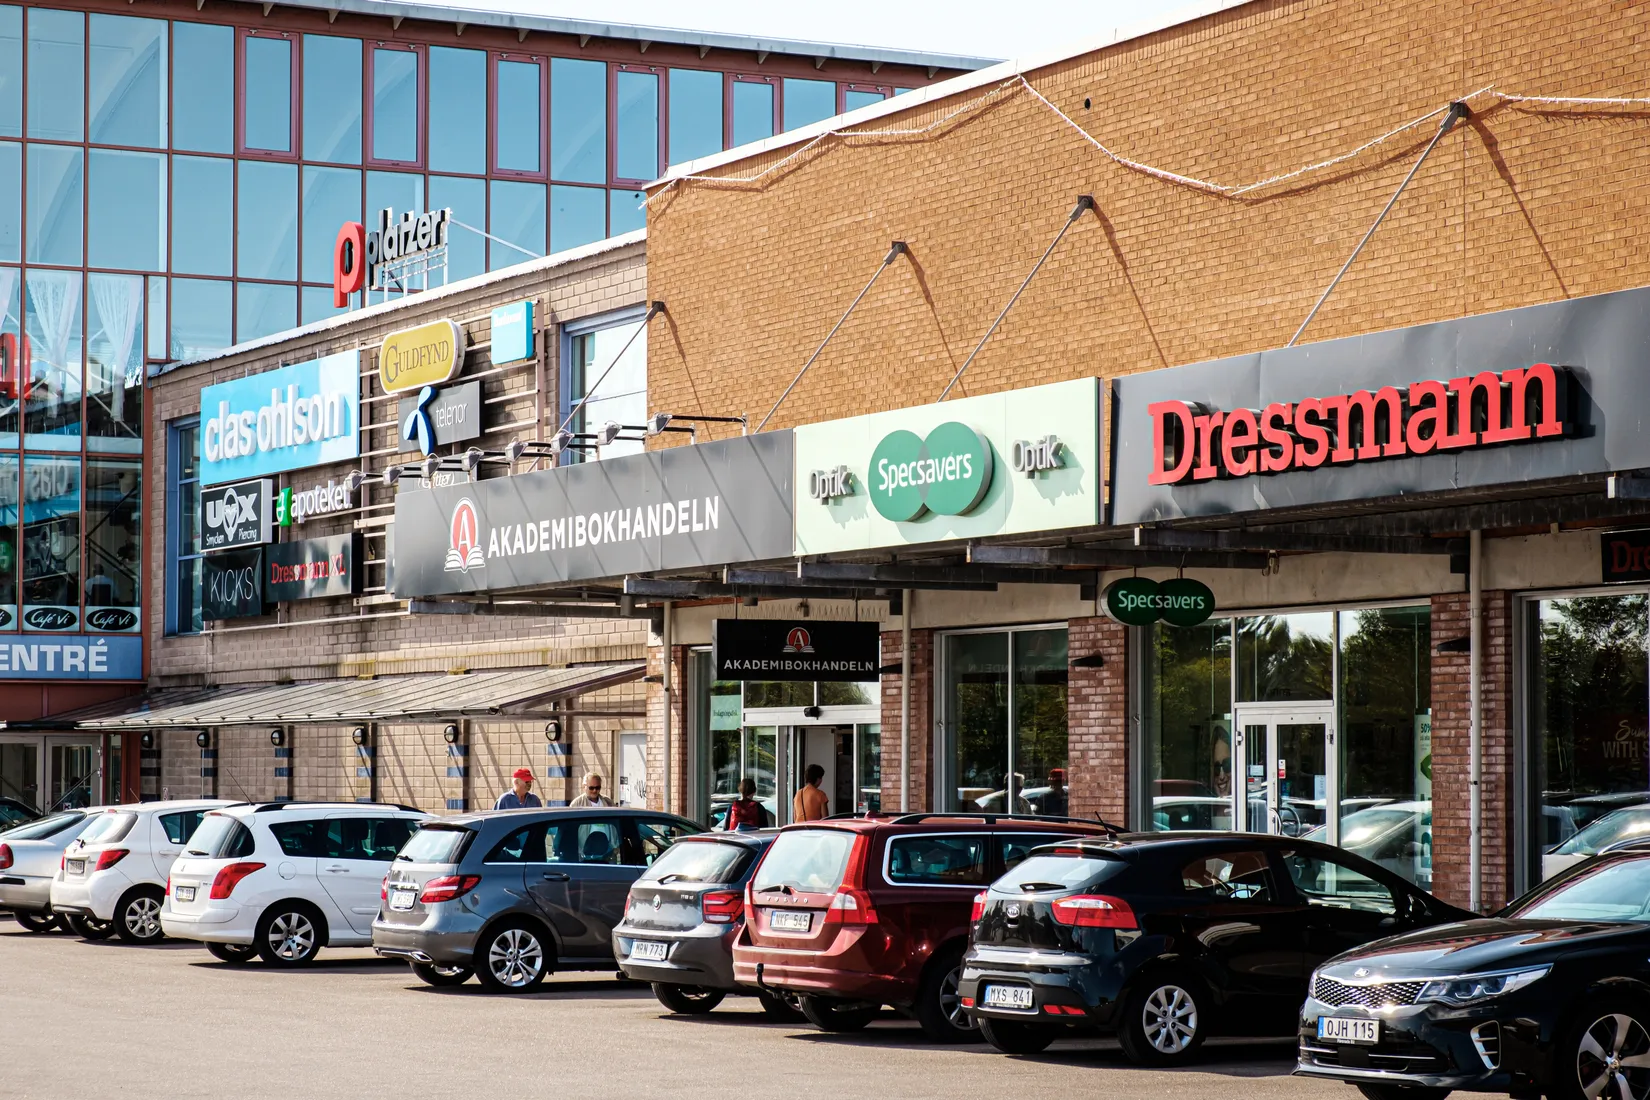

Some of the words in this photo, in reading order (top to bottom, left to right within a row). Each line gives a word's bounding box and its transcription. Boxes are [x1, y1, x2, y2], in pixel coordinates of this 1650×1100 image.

[366, 209, 446, 288] platzer
[205, 401, 257, 462] clas
[257, 384, 345, 452] ohlson
[436, 402, 468, 428] telenor
[1147, 362, 1563, 486] Dressmann
[1012, 435, 1064, 478] Optik
[809, 466, 853, 504] Optik
[878, 453, 973, 497] Specsavers
[206, 533, 225, 546] Smycken
[238, 526, 258, 542] Piercing
[487, 496, 719, 558] AKADEMIBOKHANDELN
[331, 553, 346, 576] XL
[210, 567, 254, 602] KICKS
[1118, 590, 1205, 612] Specsavers
[30, 610, 57, 628] Café
[92, 611, 118, 629] Café
[723, 659, 874, 671] AKADEMIBOKHANDELN
[649, 944, 664, 956] 773
[991, 988, 1006, 1002] MXS
[1013, 989, 1030, 1004] 841
[1327, 1020, 1348, 1037] OJH
[1353, 1022, 1374, 1039] 115
